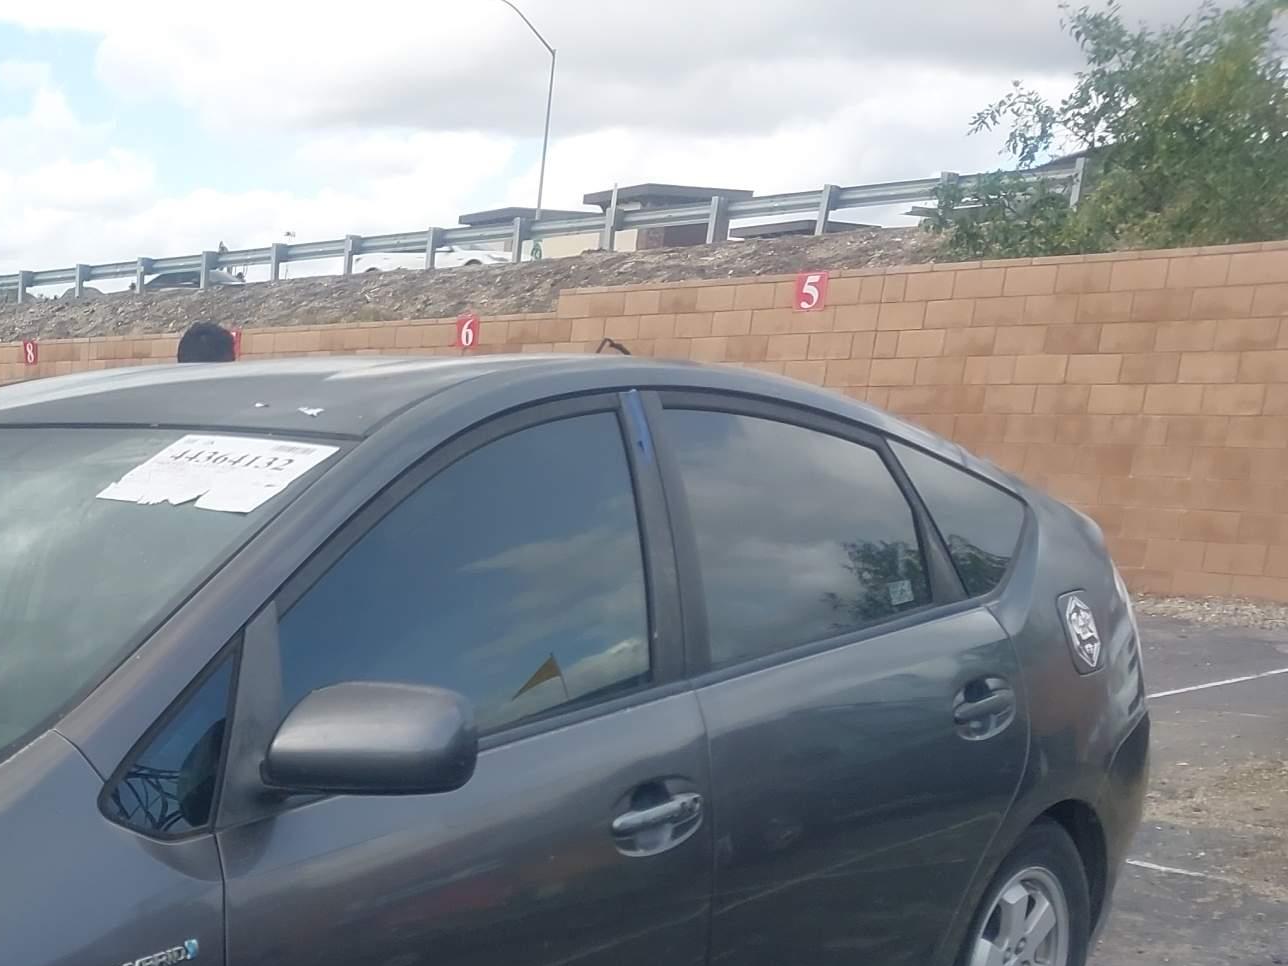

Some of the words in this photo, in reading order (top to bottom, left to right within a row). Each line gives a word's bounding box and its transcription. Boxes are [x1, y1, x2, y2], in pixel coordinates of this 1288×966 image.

[800, 275, 821, 309] 5
[461, 319, 474, 346] 6
[25, 342, 35, 364] 8
[169, 448, 295, 472] 44364132
